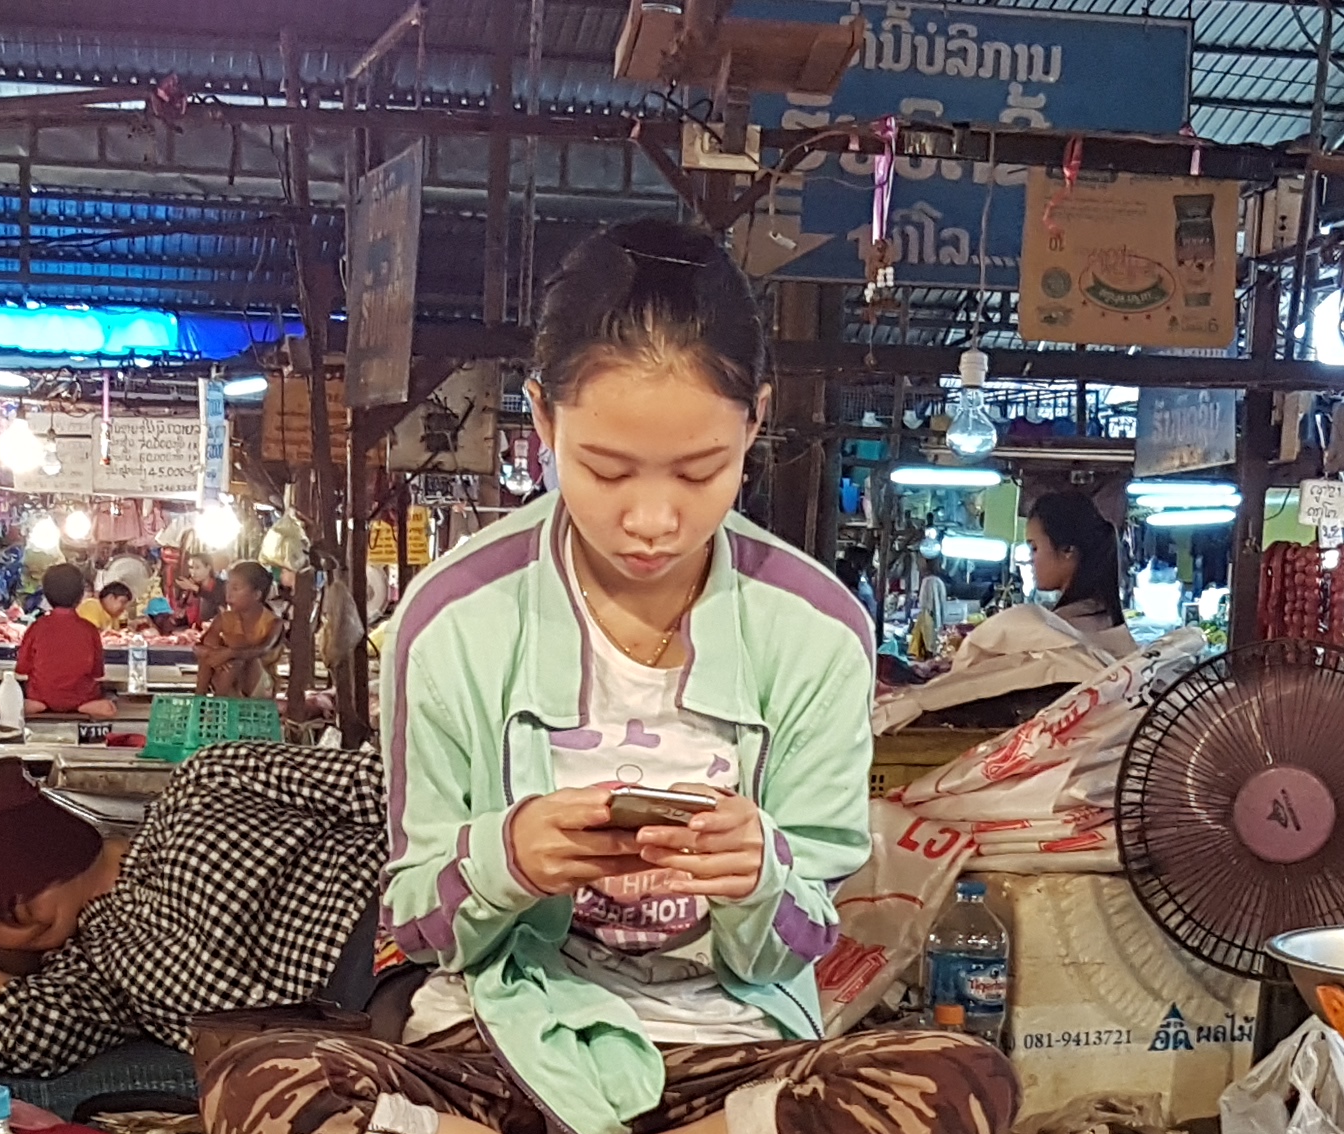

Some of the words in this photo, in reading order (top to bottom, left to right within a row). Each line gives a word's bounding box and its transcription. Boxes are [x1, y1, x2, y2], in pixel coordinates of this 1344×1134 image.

[640, 897, 690, 926] HOT
[1023, 1029, 1133, 1050] 081-9413721
[1196, 1012, 1256, 1044] ผลไม้
